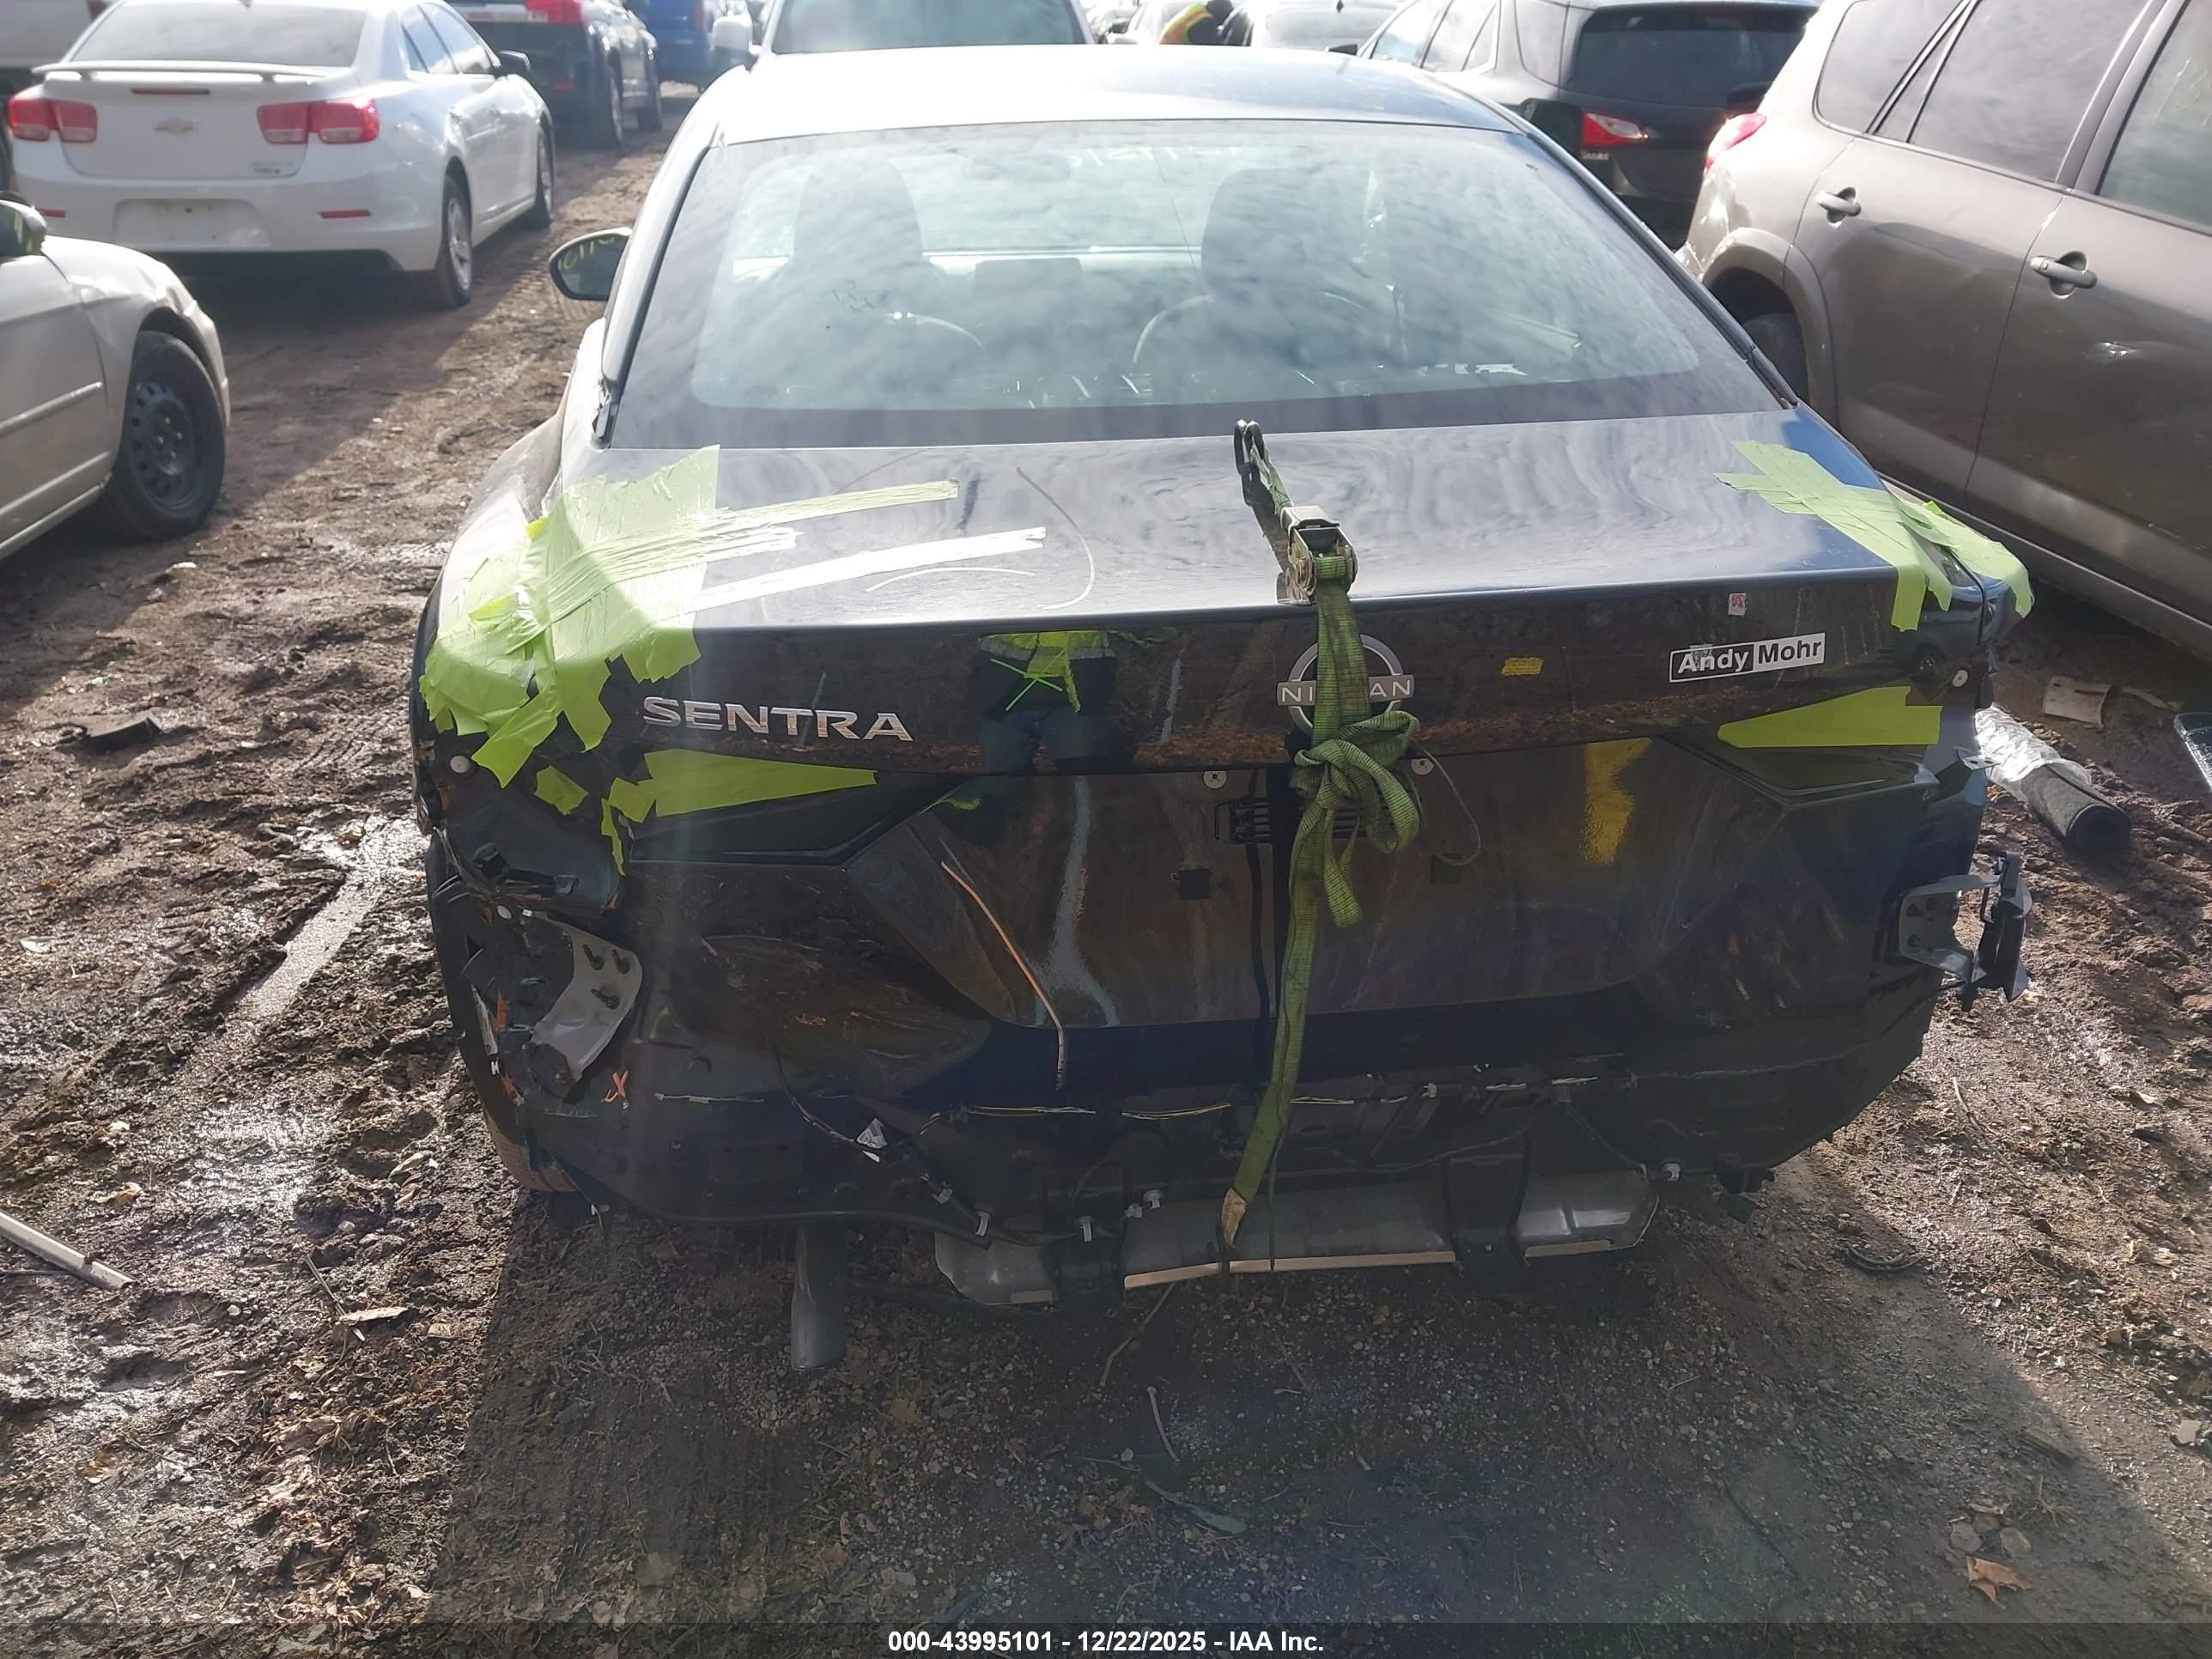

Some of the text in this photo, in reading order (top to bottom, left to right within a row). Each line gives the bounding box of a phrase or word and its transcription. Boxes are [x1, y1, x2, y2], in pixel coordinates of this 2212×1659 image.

[1677, 640, 1821, 674] Andy Mohr
[1281, 679, 1411, 702] NIAN
[643, 696, 914, 742] SENTRA
